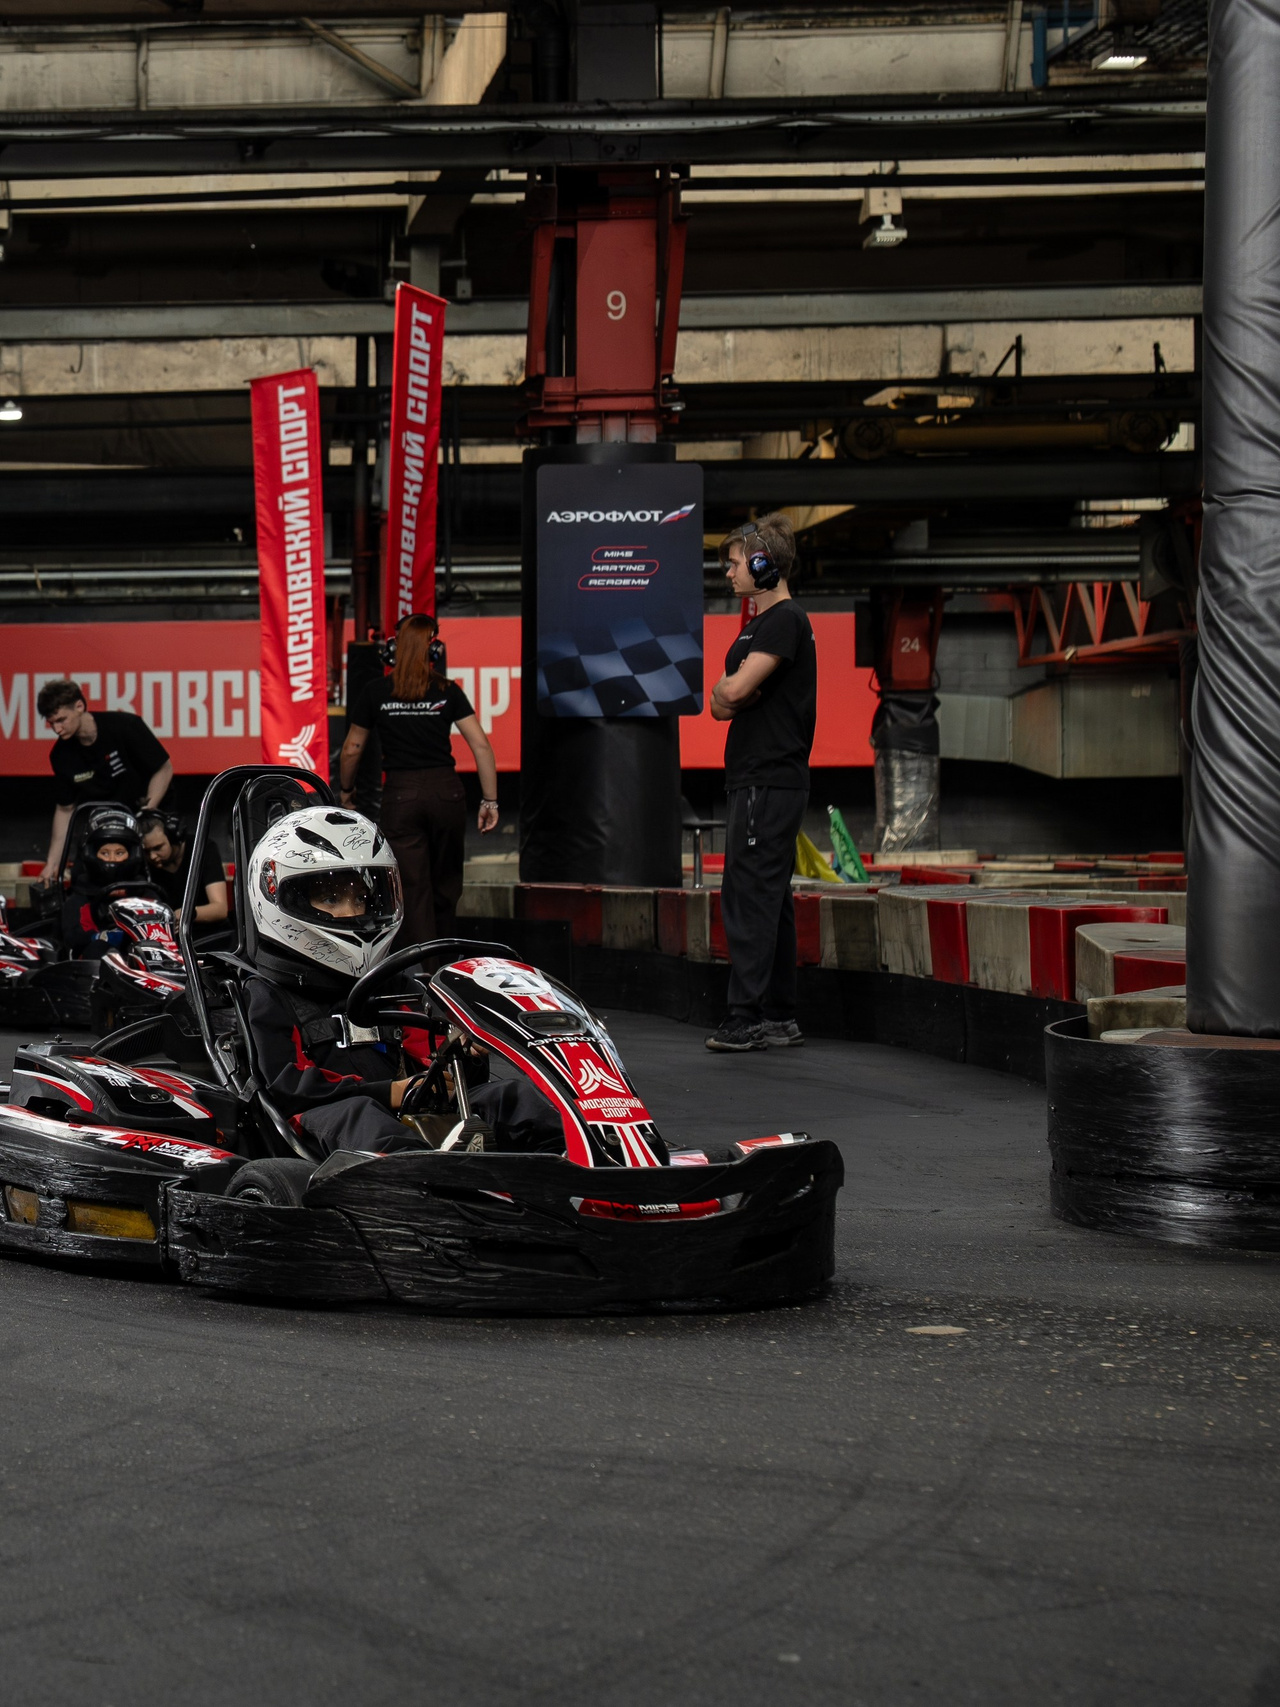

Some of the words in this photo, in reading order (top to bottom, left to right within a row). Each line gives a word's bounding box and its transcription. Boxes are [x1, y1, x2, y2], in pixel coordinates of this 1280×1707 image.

[606, 290, 627, 321] 9
[405, 302, 434, 425] СПОРТ
[278, 385, 308, 484] СПОРТ
[546, 509, 663, 524] АЭРОФЛОТ
[588, 578, 650, 586] ACADEMY
[277, 494, 314, 702] МОСКОВСКИЙ
[900, 636, 921, 654] 24
[578, 1097, 644, 1110] МОСКОВСКИЙ
[601, 1107, 633, 1118] СПОРТ
